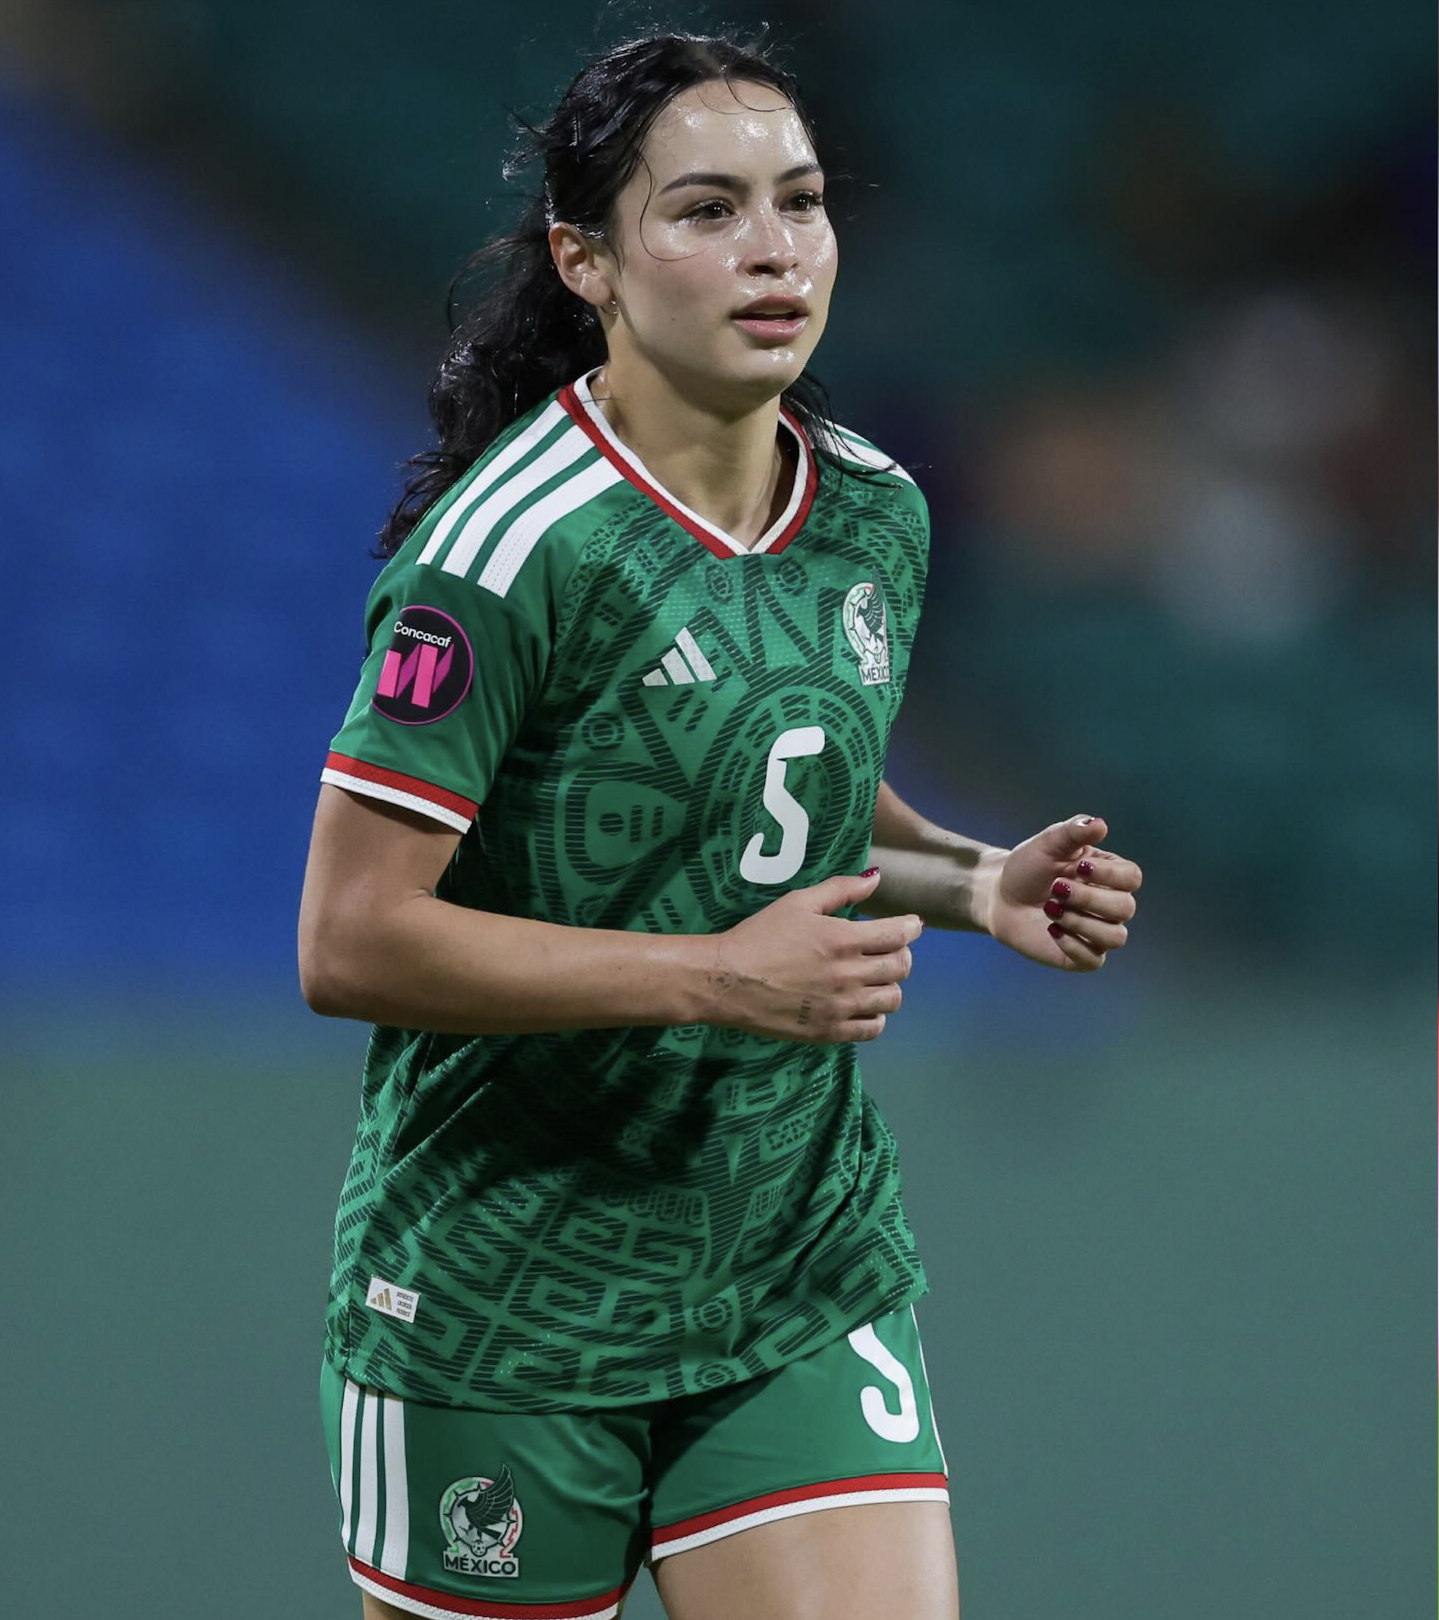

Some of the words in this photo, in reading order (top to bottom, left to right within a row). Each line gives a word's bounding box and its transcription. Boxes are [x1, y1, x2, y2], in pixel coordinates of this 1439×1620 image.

[394, 621, 451, 647] Concacaf
[740, 726, 825, 885] 5
[847, 1321, 920, 1443] 5
[445, 1554, 516, 1575] MÉXICO
